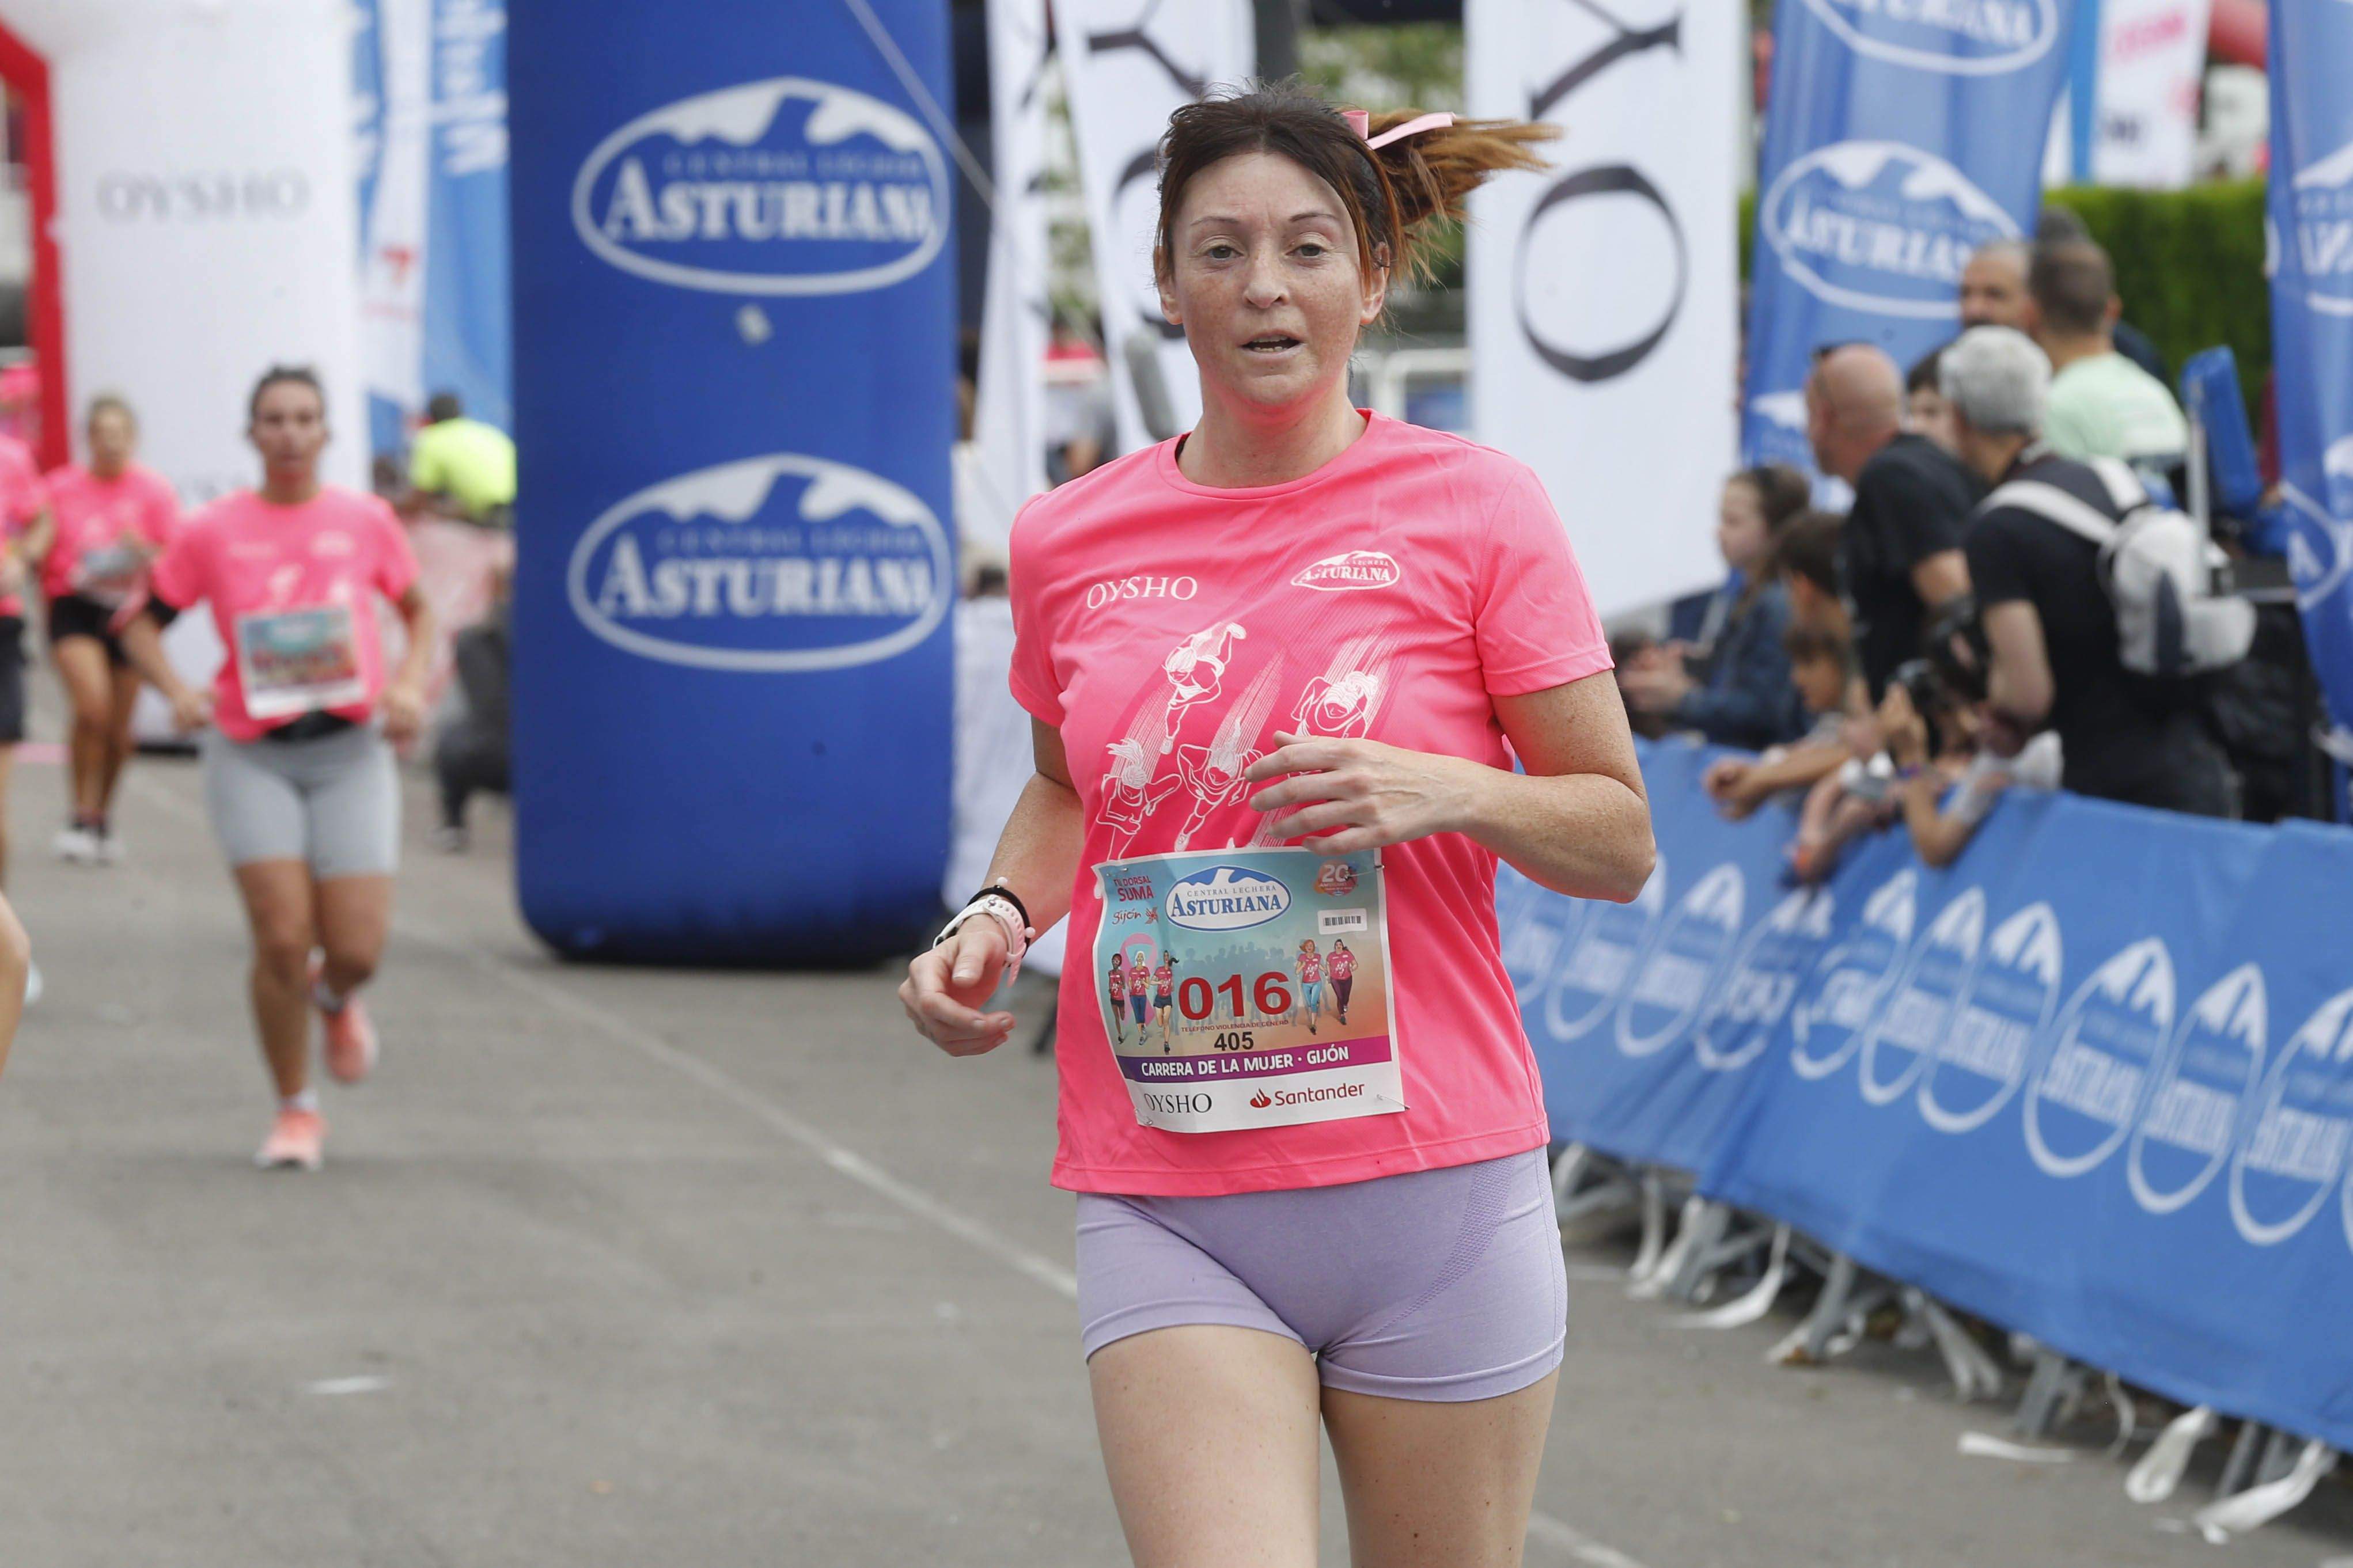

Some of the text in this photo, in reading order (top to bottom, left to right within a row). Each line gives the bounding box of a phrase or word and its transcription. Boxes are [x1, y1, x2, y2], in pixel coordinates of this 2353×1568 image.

[1087, 576, 1198, 609] OYSHO
[1124, 875, 1151, 886] DORSAL
[1187, 884, 1277, 897] CENTRAL LECHERA
[1117, 885, 1154, 902] SUMA
[1170, 893, 1282, 917] ASTURIANA
[1112, 908, 1142, 925] gijón
[1179, 971, 1291, 1020] 016
[1214, 1031, 1254, 1051] 405
[1141, 1062, 1193, 1077] CARRERA
[1198, 1060, 1217, 1075] DE
[1221, 1059, 1240, 1073] LA
[1244, 1053, 1294, 1072] MUJER
[1306, 1044, 1350, 1065] GIJÓN
[1143, 1083, 1365, 1114] OYSHO Santander
